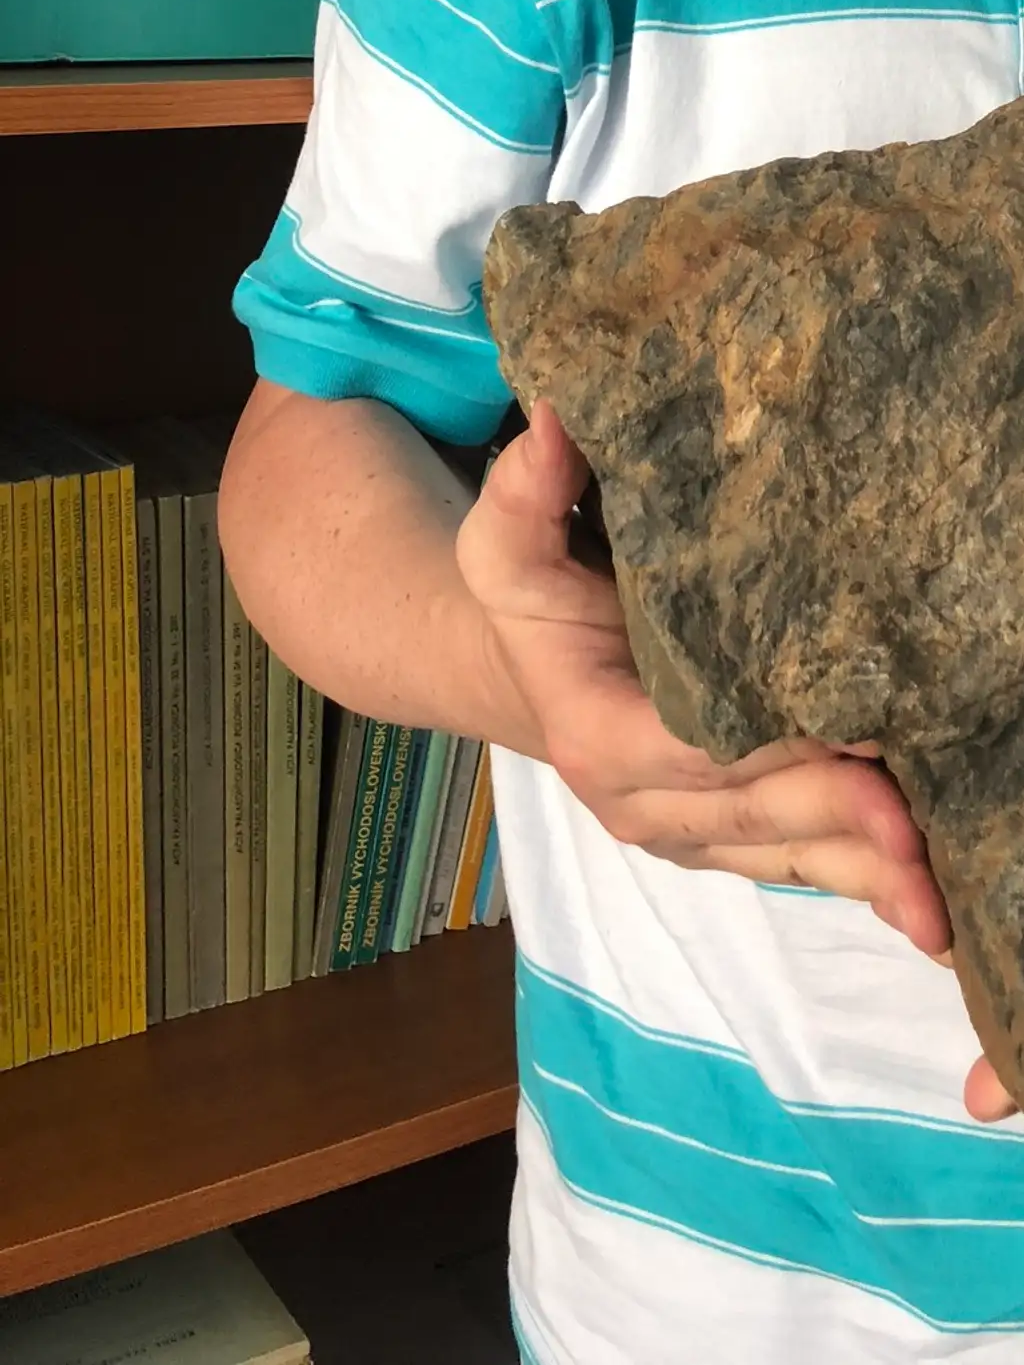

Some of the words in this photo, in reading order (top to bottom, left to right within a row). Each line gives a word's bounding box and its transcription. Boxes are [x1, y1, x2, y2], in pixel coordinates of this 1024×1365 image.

[373, 728, 413, 876] VÝCHODOSLOVENS
[338, 884, 362, 954] ZBORNÍK
[362, 878, 386, 950] ZBORNÍK
